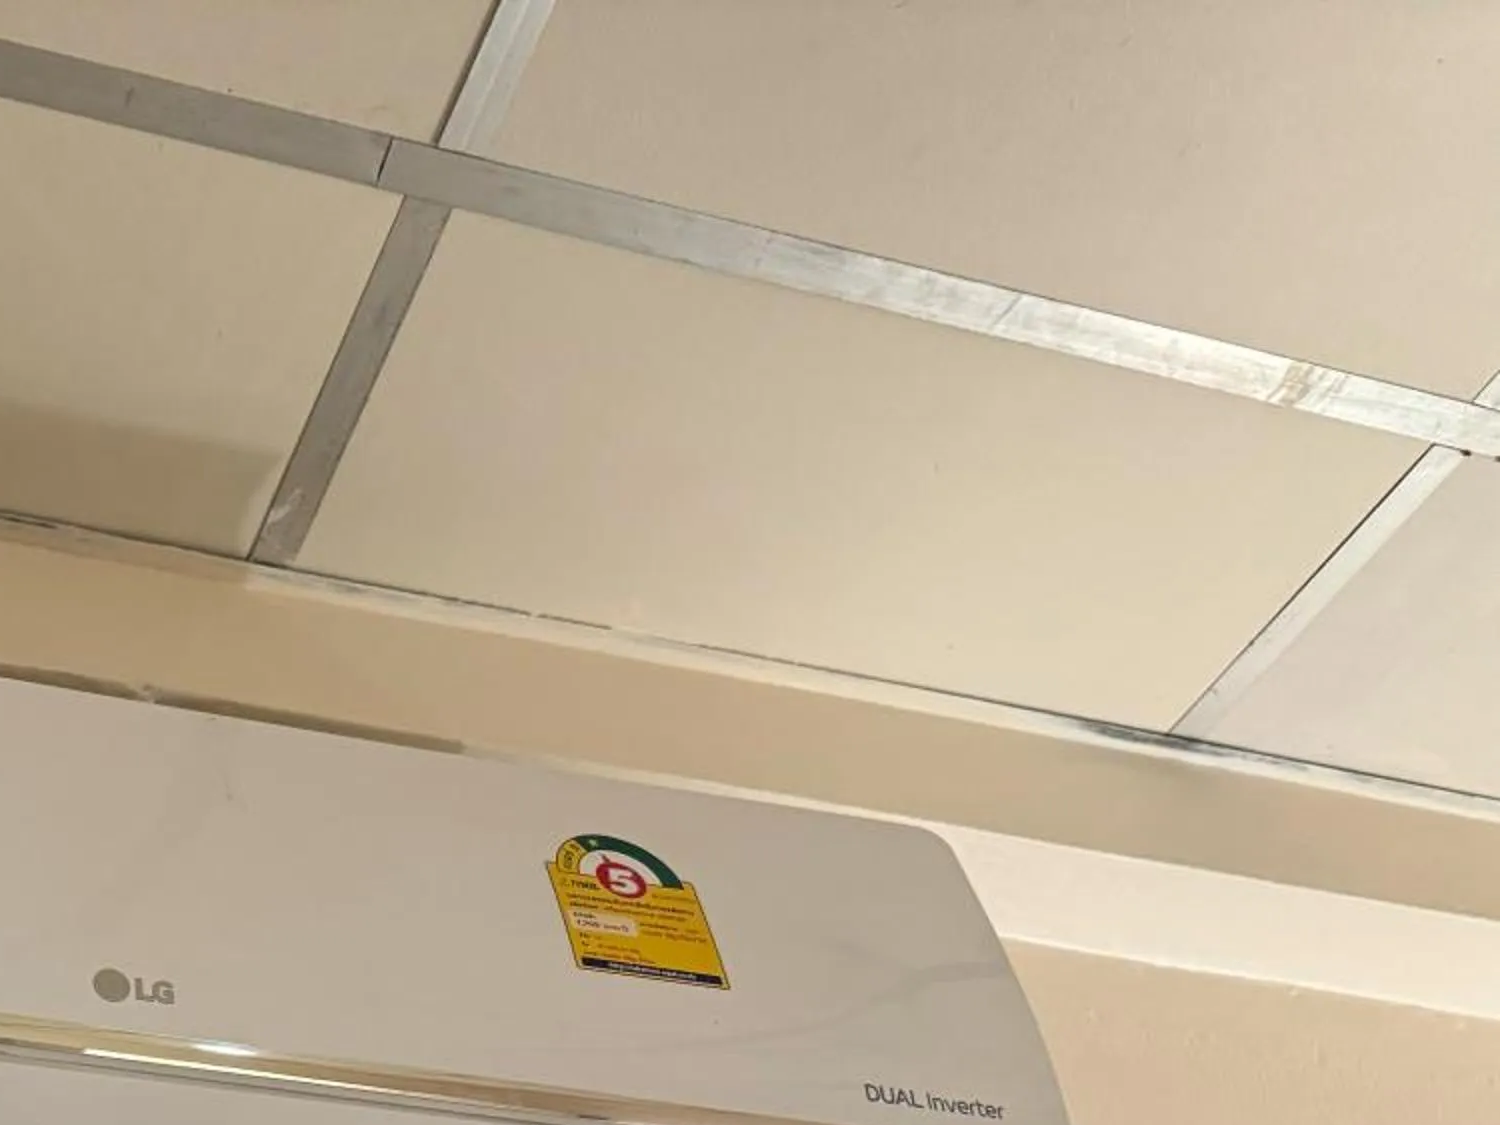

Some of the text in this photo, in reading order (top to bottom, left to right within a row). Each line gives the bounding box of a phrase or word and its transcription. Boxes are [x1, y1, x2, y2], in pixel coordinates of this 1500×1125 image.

[608, 867, 639, 895] 5
[134, 977, 175, 1005] LG
[863, 1082, 1005, 1120] DUAL Inverter
